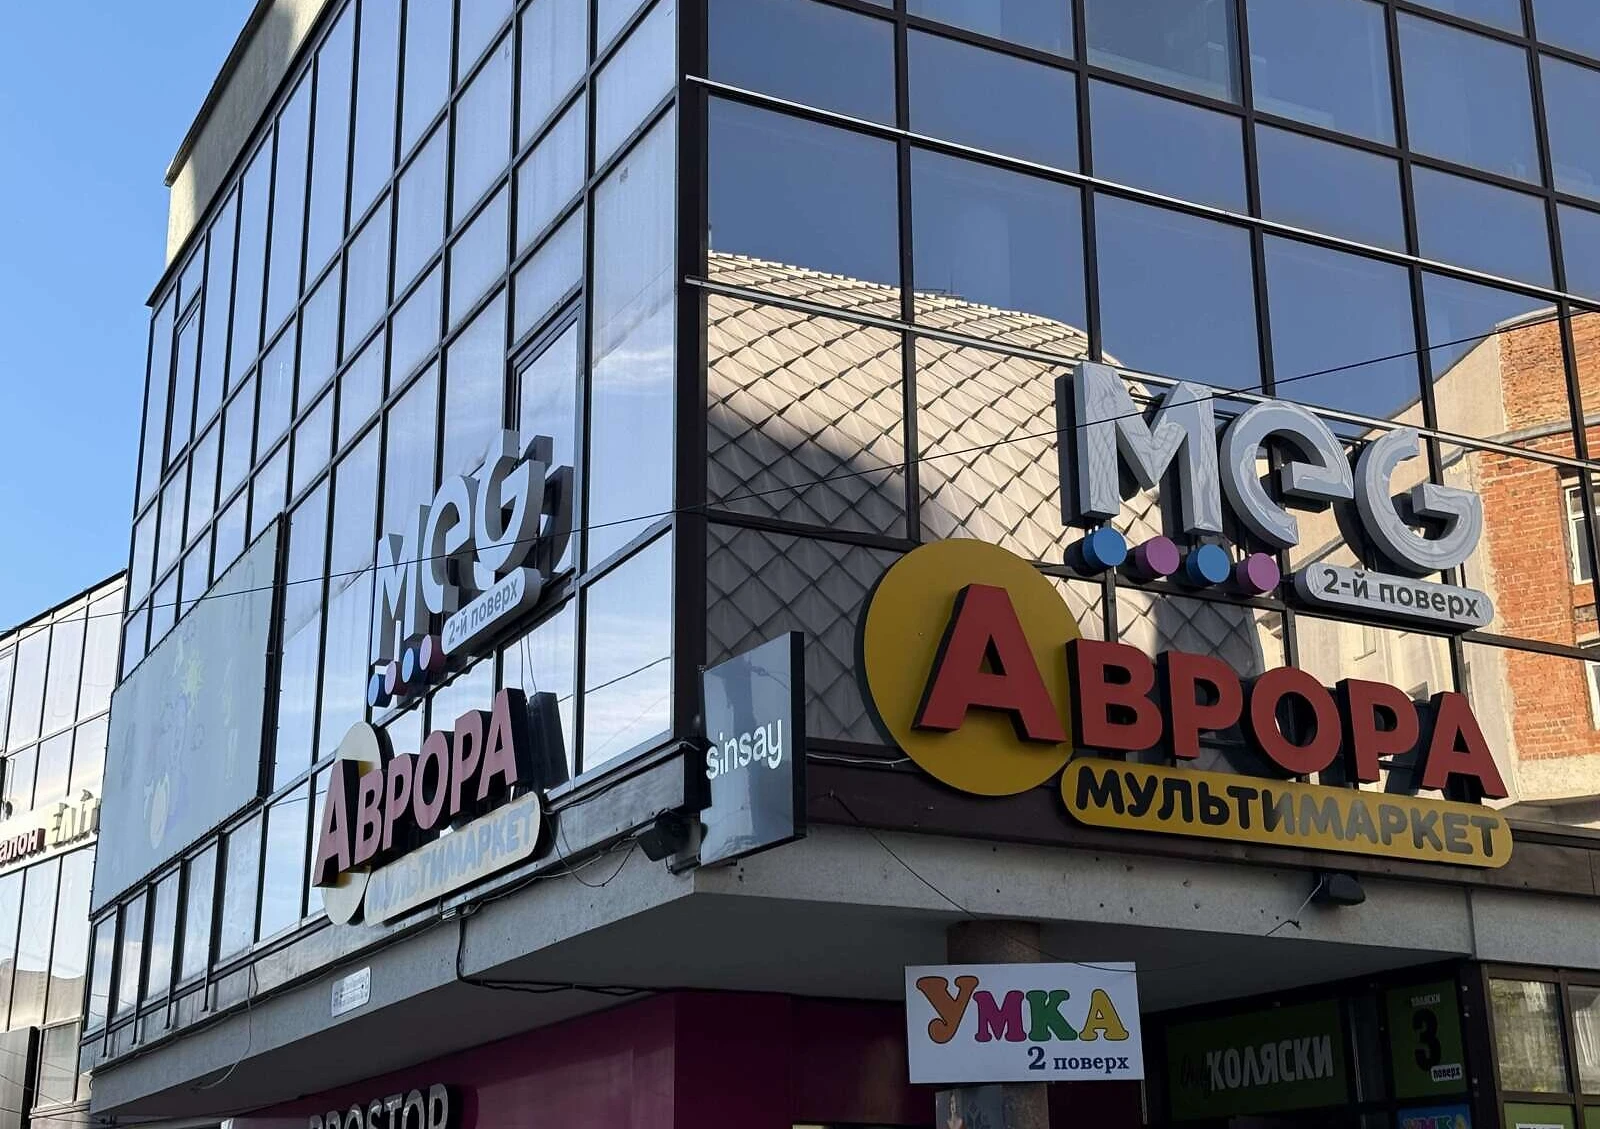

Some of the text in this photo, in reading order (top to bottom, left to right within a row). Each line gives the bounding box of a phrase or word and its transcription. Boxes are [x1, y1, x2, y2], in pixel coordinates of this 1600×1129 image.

[447, 577, 519, 646] 2-й поверх
[1322, 568, 1482, 620] 2-й поверх
[706, 719, 782, 780] sinsay
[1075, 765, 1500, 858] МУЛЬТИМАРКЕТ
[916, 975, 1130, 1045] УМКА
[1412, 1008, 1442, 1072] 3
[1027, 1046, 1130, 1075] 2 поверх
[1206, 1034, 1335, 1092] КОЛЯСКИ
